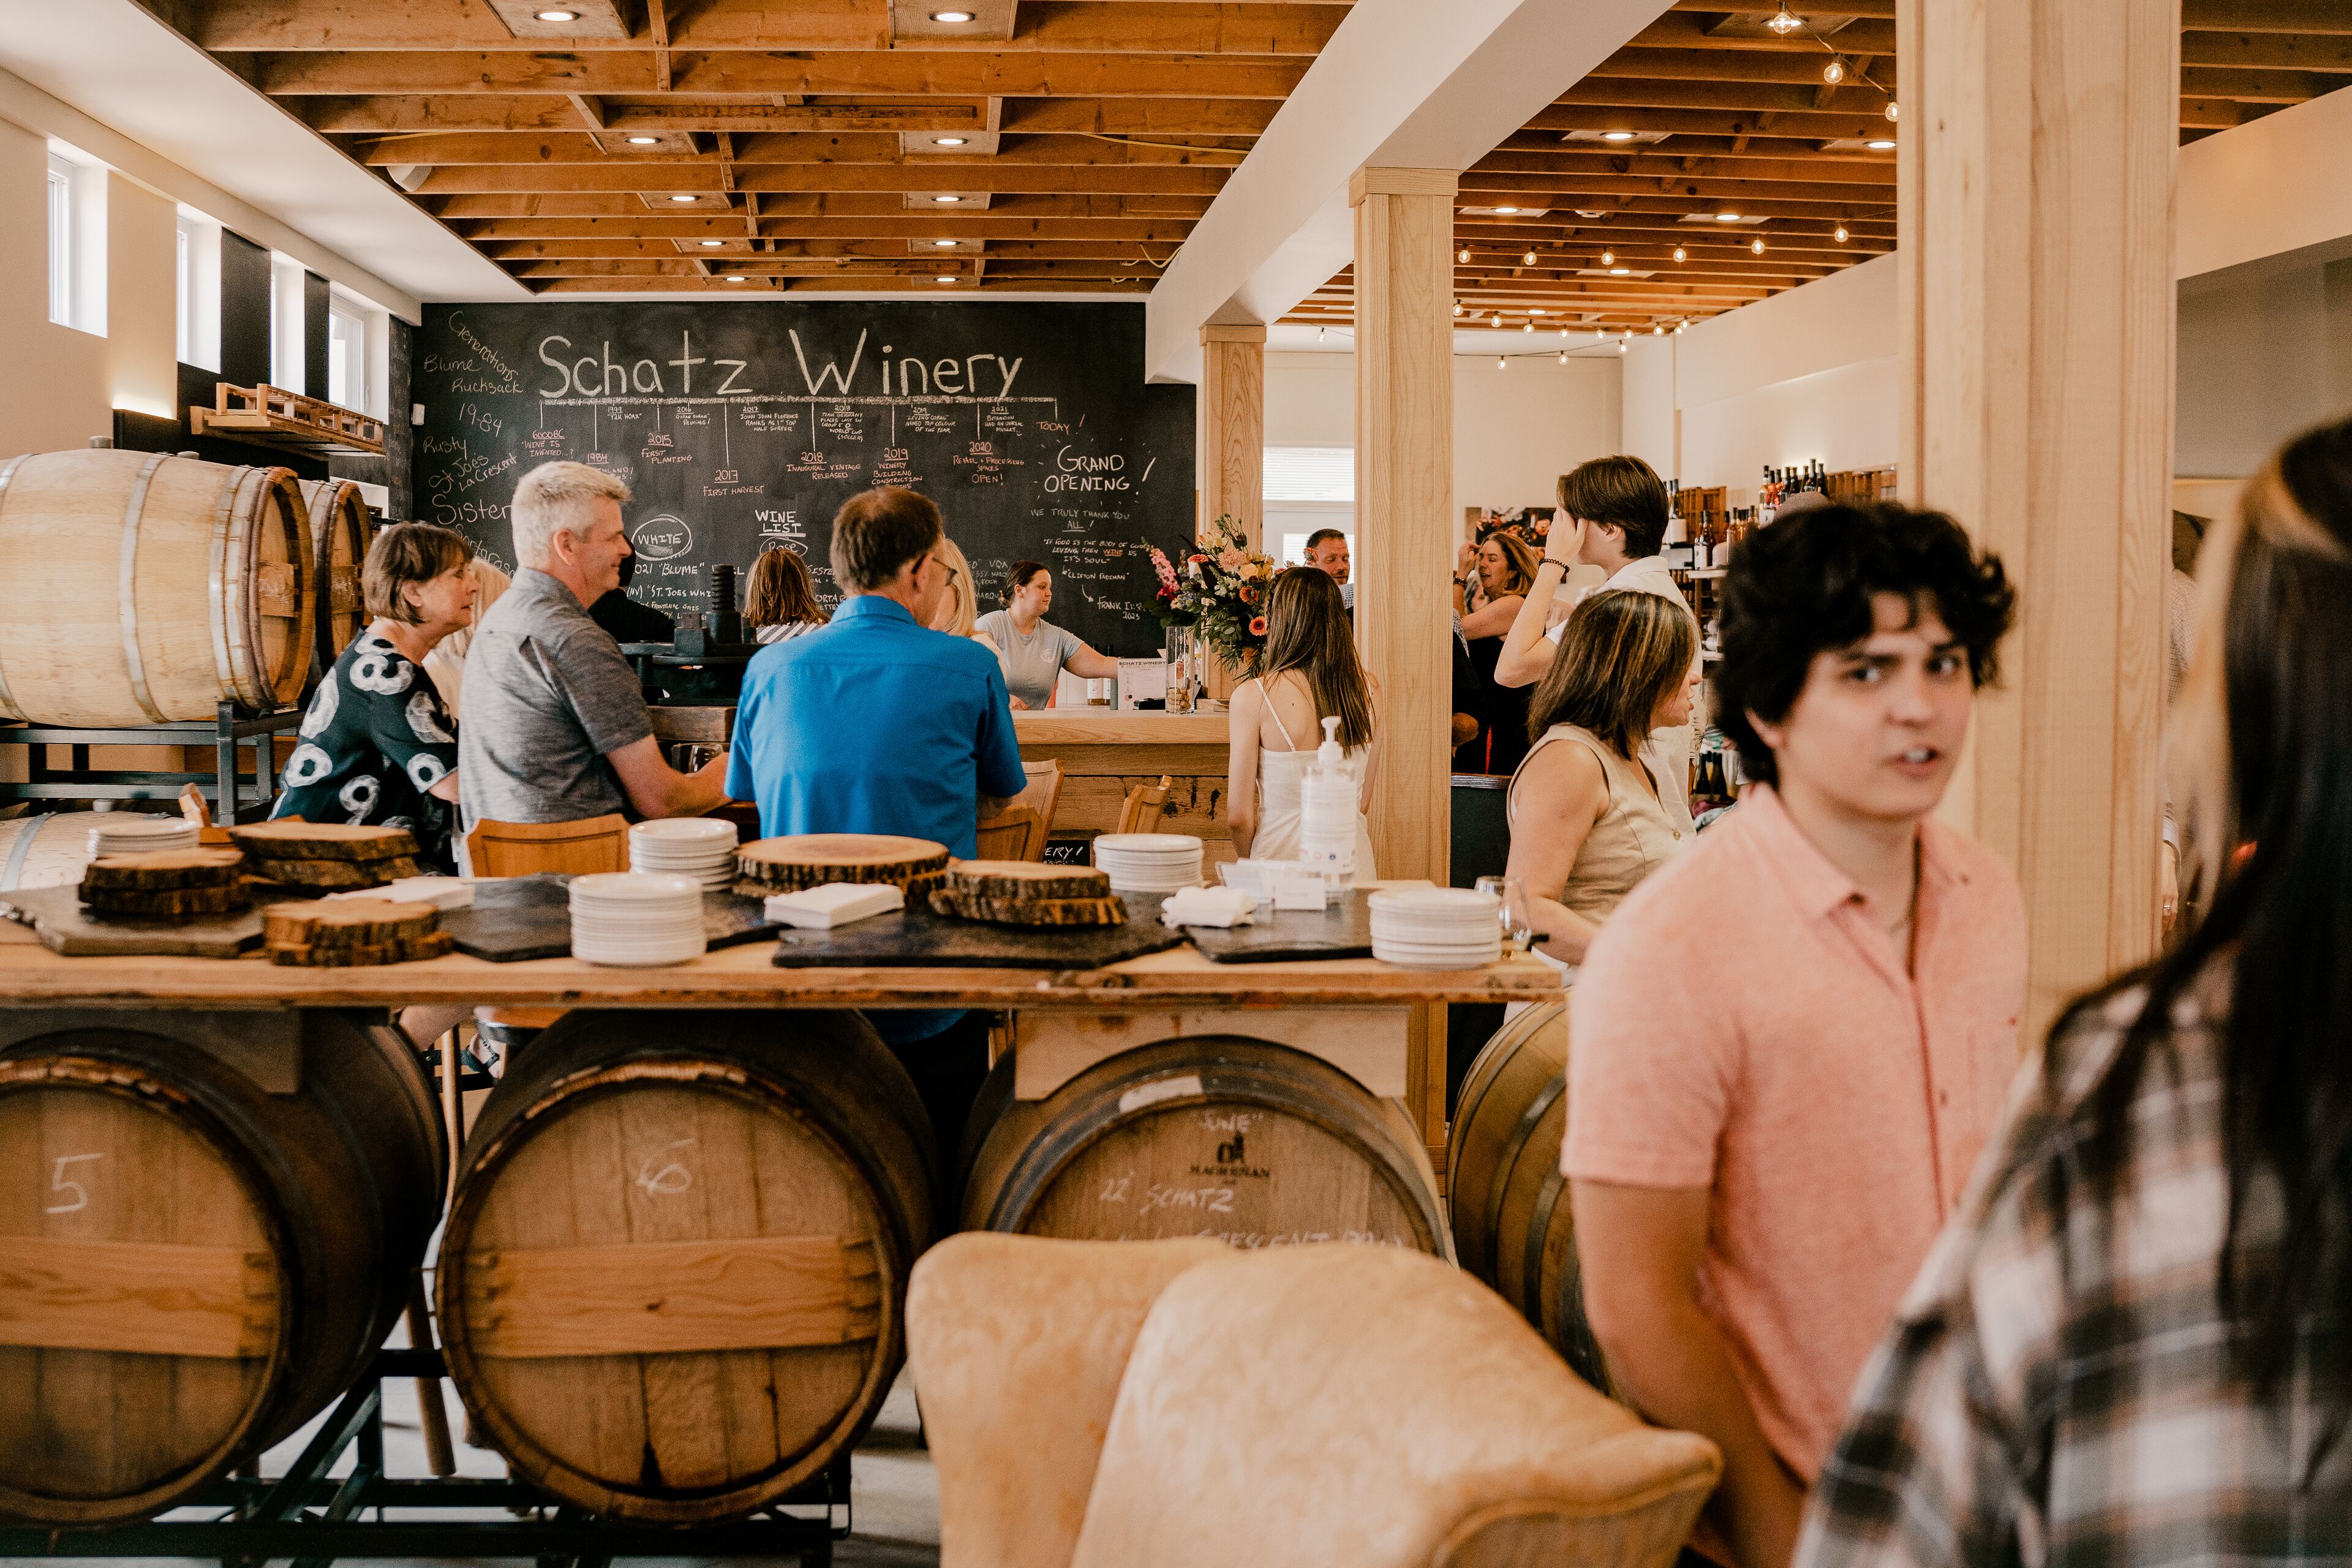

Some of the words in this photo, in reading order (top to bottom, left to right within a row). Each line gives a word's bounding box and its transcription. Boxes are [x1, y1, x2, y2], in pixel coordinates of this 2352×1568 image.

[450, 311, 519, 381] Generations
[424, 355, 481, 372] Blume
[539, 330, 753, 398] Schatz
[789, 328, 1022, 397] Winery
[451, 377, 523, 394] Rucksack
[1036, 421, 1070, 435] TODAY
[647, 433, 672, 445] 2015
[423, 436, 467, 460] Rusty
[641, 448, 666, 458] FIRST
[970, 442, 992, 453] 2020
[588, 453, 608, 463] 1984
[652, 455, 693, 464] PLANTING
[801, 451, 824, 462] 2018
[884, 448, 908, 461] 2019
[1057, 445, 1125, 472] GRAND
[459, 478, 475, 492] La
[475, 453, 517, 481] Crescent
[714, 469, 739, 483] 2017
[429, 470, 454, 493] St
[872, 476, 922, 485] CONSTRUCTION
[1044, 474, 1130, 492] OPENING
[704, 486, 727, 497] FIRST
[732, 485, 765, 495] HARVEST
[432, 494, 512, 525] Sister
[1030, 508, 1044, 517] WE
[1052, 509, 1079, 518] TRULY
[755, 510, 796, 523] WINE
[763, 523, 802, 534] LIST
[1067, 520, 1084, 529] ALL
[638, 532, 684, 545] WHITE
[635, 564, 652, 574] 021
[665, 587, 687, 597] JOES
[815, 594, 838, 603] ORTA
[1097, 595, 1121, 610] FRANK
[1044, 846, 1073, 860] ERY
[46, 1152, 104, 1214] 5
